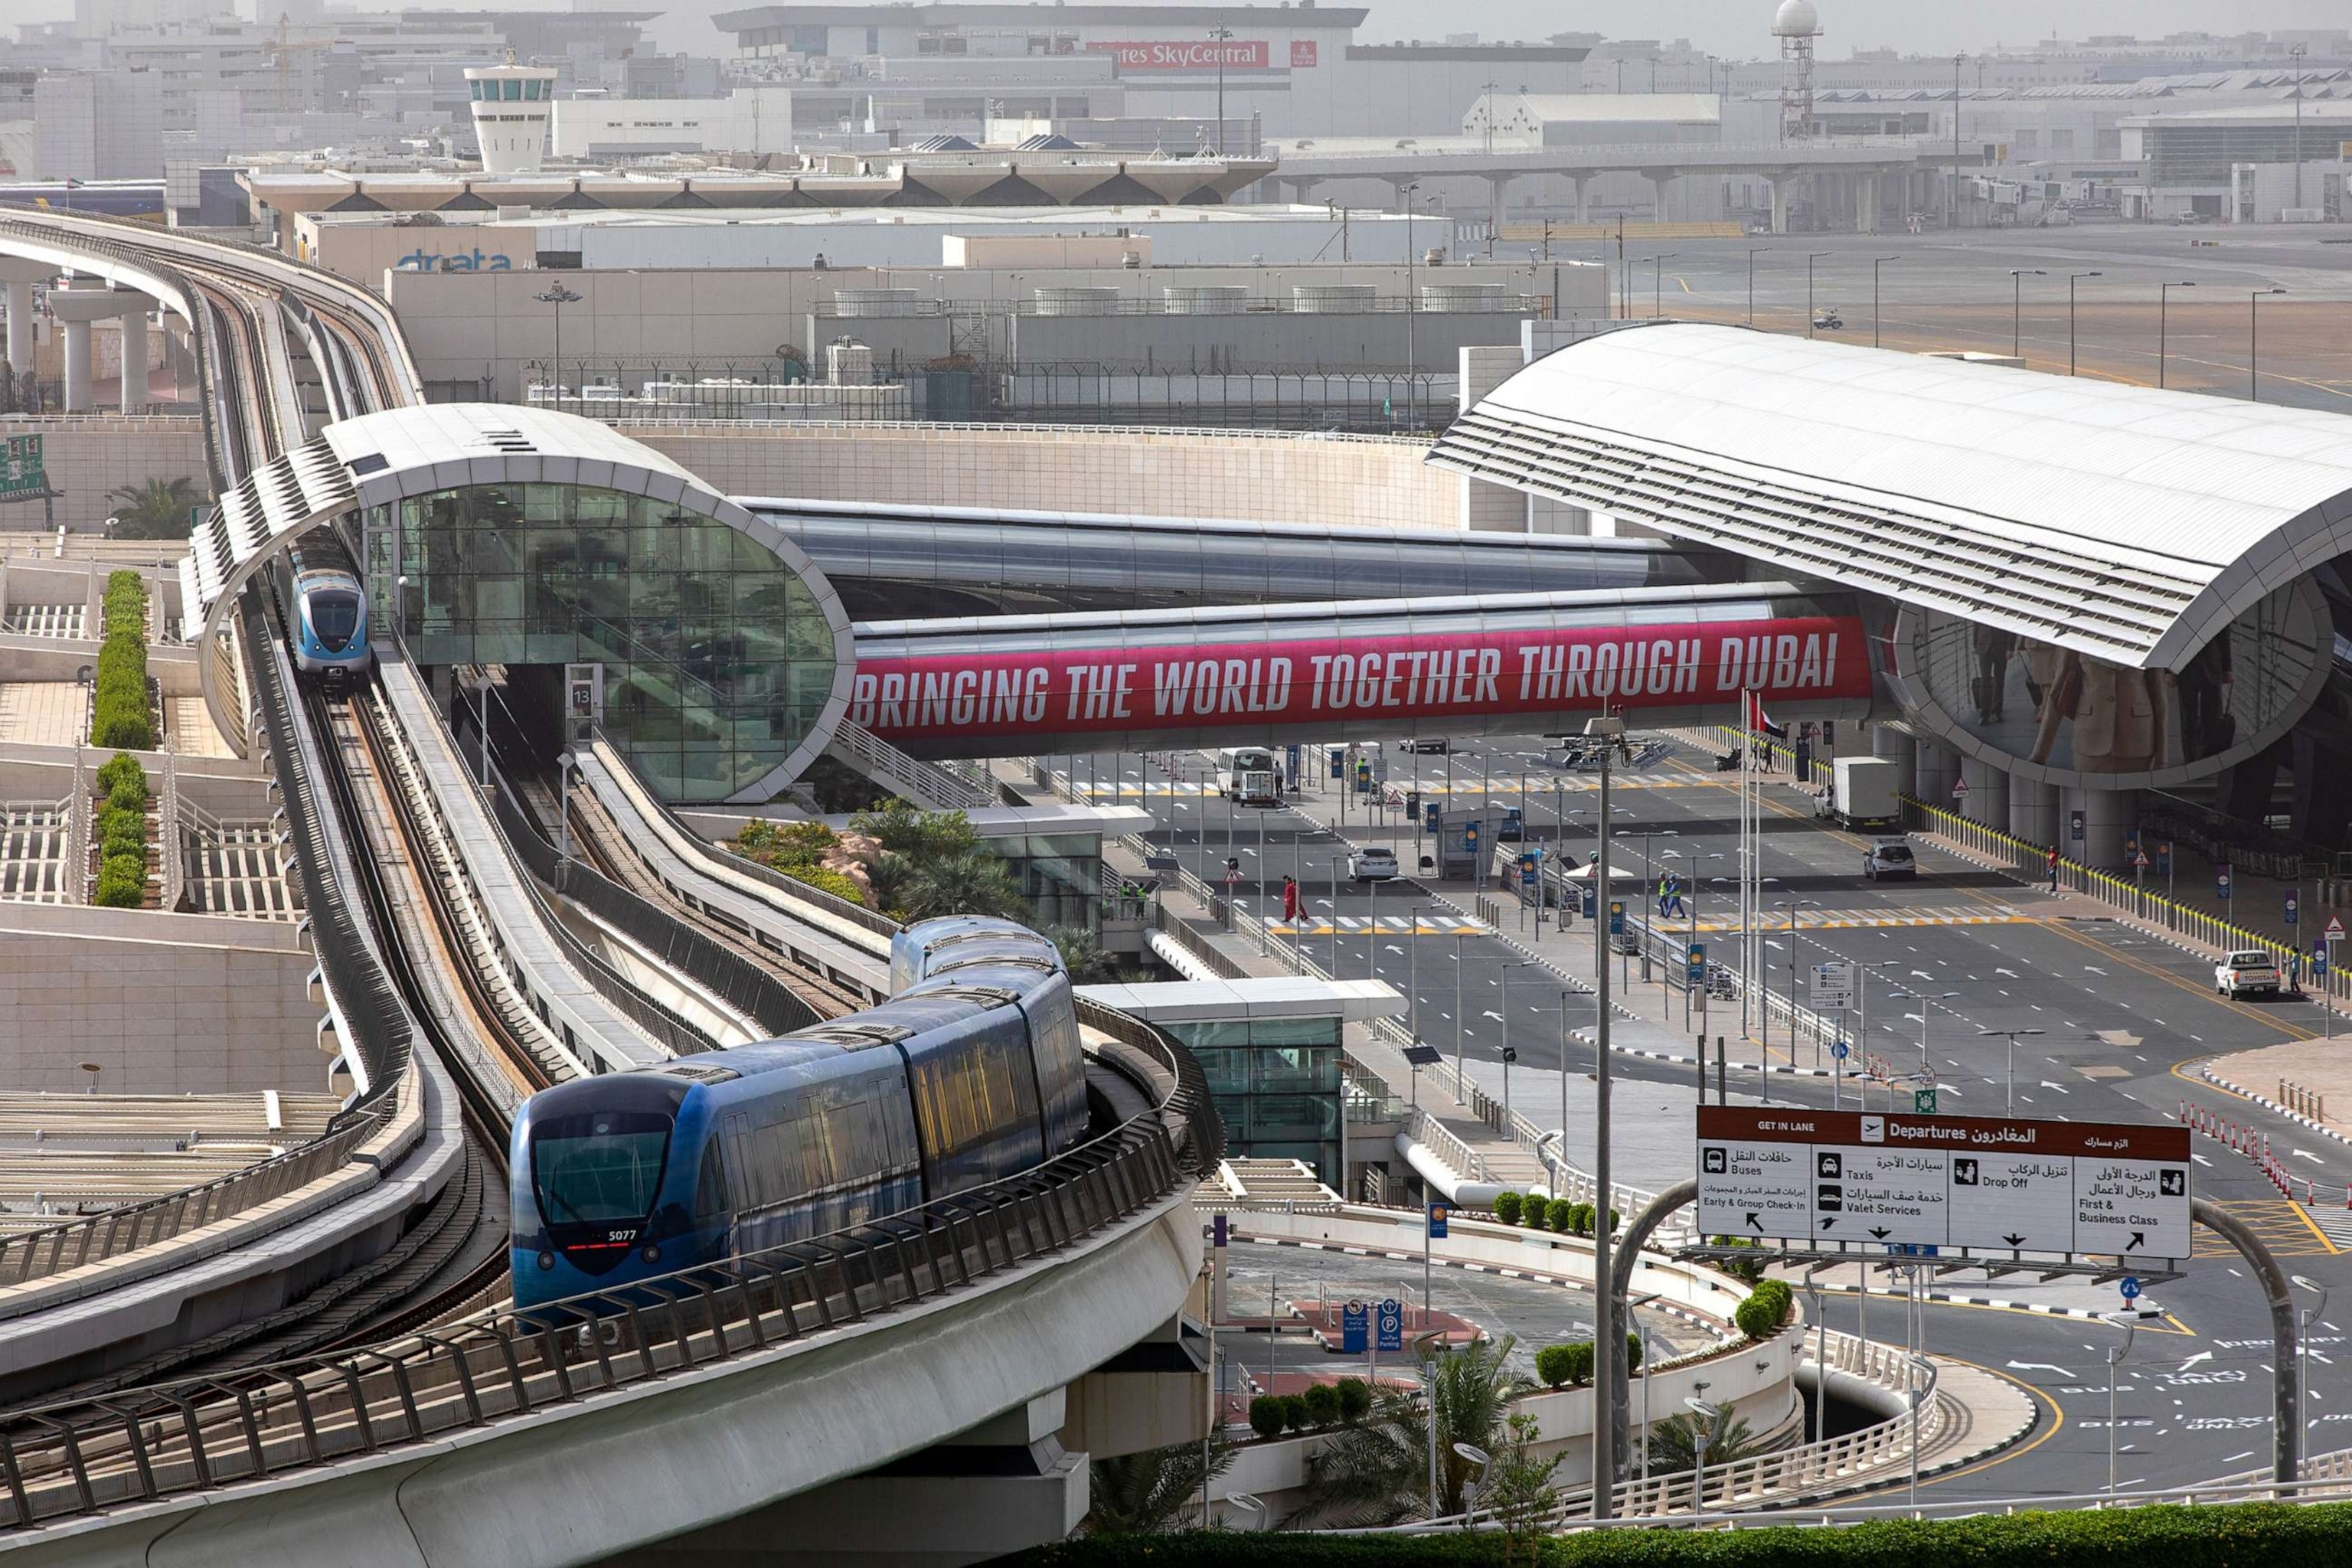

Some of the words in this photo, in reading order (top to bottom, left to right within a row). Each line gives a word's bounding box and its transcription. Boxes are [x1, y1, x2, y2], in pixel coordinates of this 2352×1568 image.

[1153, 44, 1256, 67] SkyCentral
[851, 667, 1049, 729] BRINGING
[1066, 664, 1136, 720] THE
[1154, 658, 1293, 717] WORLD
[1310, 648, 1501, 710] TOGETHER
[1519, 638, 1700, 701] THROUGH
[1715, 632, 1838, 691] DUBAI
[574, 690, 590, 704] 13
[1758, 1121, 1775, 1131] GET
[1778, 1122, 1788, 1131] IN
[1791, 1122, 1815, 1132] LANE
[1890, 1122, 1966, 1140] Departures
[1971, 1127, 2036, 1143] المغادرون
[2085, 1137, 2112, 1148] مسارك
[2114, 1138, 2129, 1149] الزم
[1730, 1150, 1755, 1162] النقل
[1759, 1152, 1792, 1163] حافلات
[1877, 1155, 1903, 1171] الأجرة
[1906, 1158, 1943, 1172] سيارات
[1732, 1165, 1762, 1176] Buses
[1847, 1170, 1873, 1181] Taxis
[2008, 1164, 2040, 1176] الركاب
[2042, 1165, 2068, 1178] تنزيل
[2096, 1166, 2122, 1181] الأولى
[2125, 1168, 2156, 1182] الدرجة
[1983, 1178, 2007, 1188] Drop
[2011, 1178, 2028, 1187] Off
[2089, 1183, 2123, 1196] الأعمال
[1847, 1187, 1890, 1202] السيارات
[1893, 1192, 1915, 1201] صف
[1917, 1191, 1943, 1202] خدمة
[2126, 1186, 2156, 1199] ورجال
[1704, 1197, 1726, 1207] Early
[1728, 1198, 1734, 1207] &
[1737, 1199, 1764, 1209] Group
[1767, 1200, 1805, 1210] Check-In
[1847, 1203, 1873, 1214] Valet
[1877, 1204, 1921, 1216] Services
[2079, 1199, 2103, 1210] First
[2106, 1200, 2113, 1210] &
[2079, 1212, 2126, 1224] Business
[2129, 1215, 2158, 1226] Class
[609, 1230, 636, 1241] 5077
[2167, 1376, 2247, 1385] ONLY
[2079, 1419, 2154, 1428] BUS
